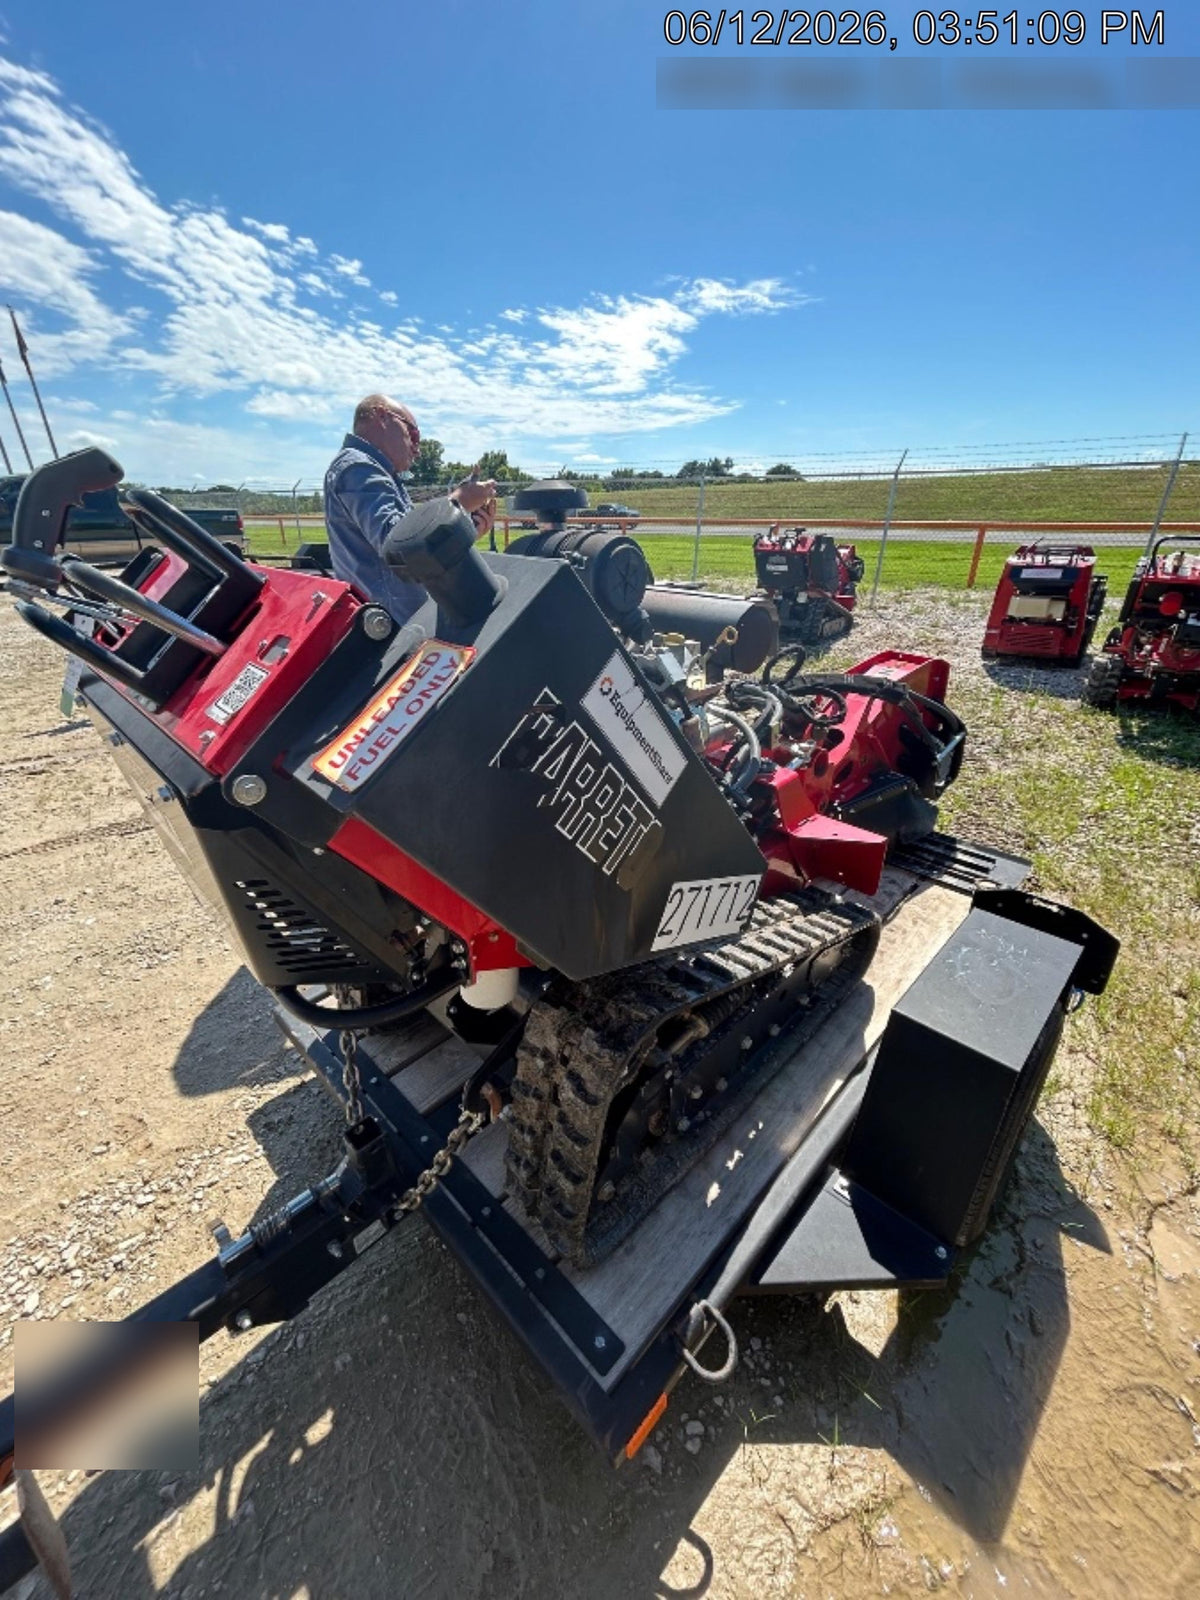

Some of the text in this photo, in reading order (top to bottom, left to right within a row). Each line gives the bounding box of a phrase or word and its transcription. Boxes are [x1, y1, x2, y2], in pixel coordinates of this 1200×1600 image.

[328, 651, 441, 769] UNLEADED
[345, 656, 459, 781] FUEL ONLY
[609, 689, 674, 785] EquipmentShare
[657, 879, 757, 944] 271712
